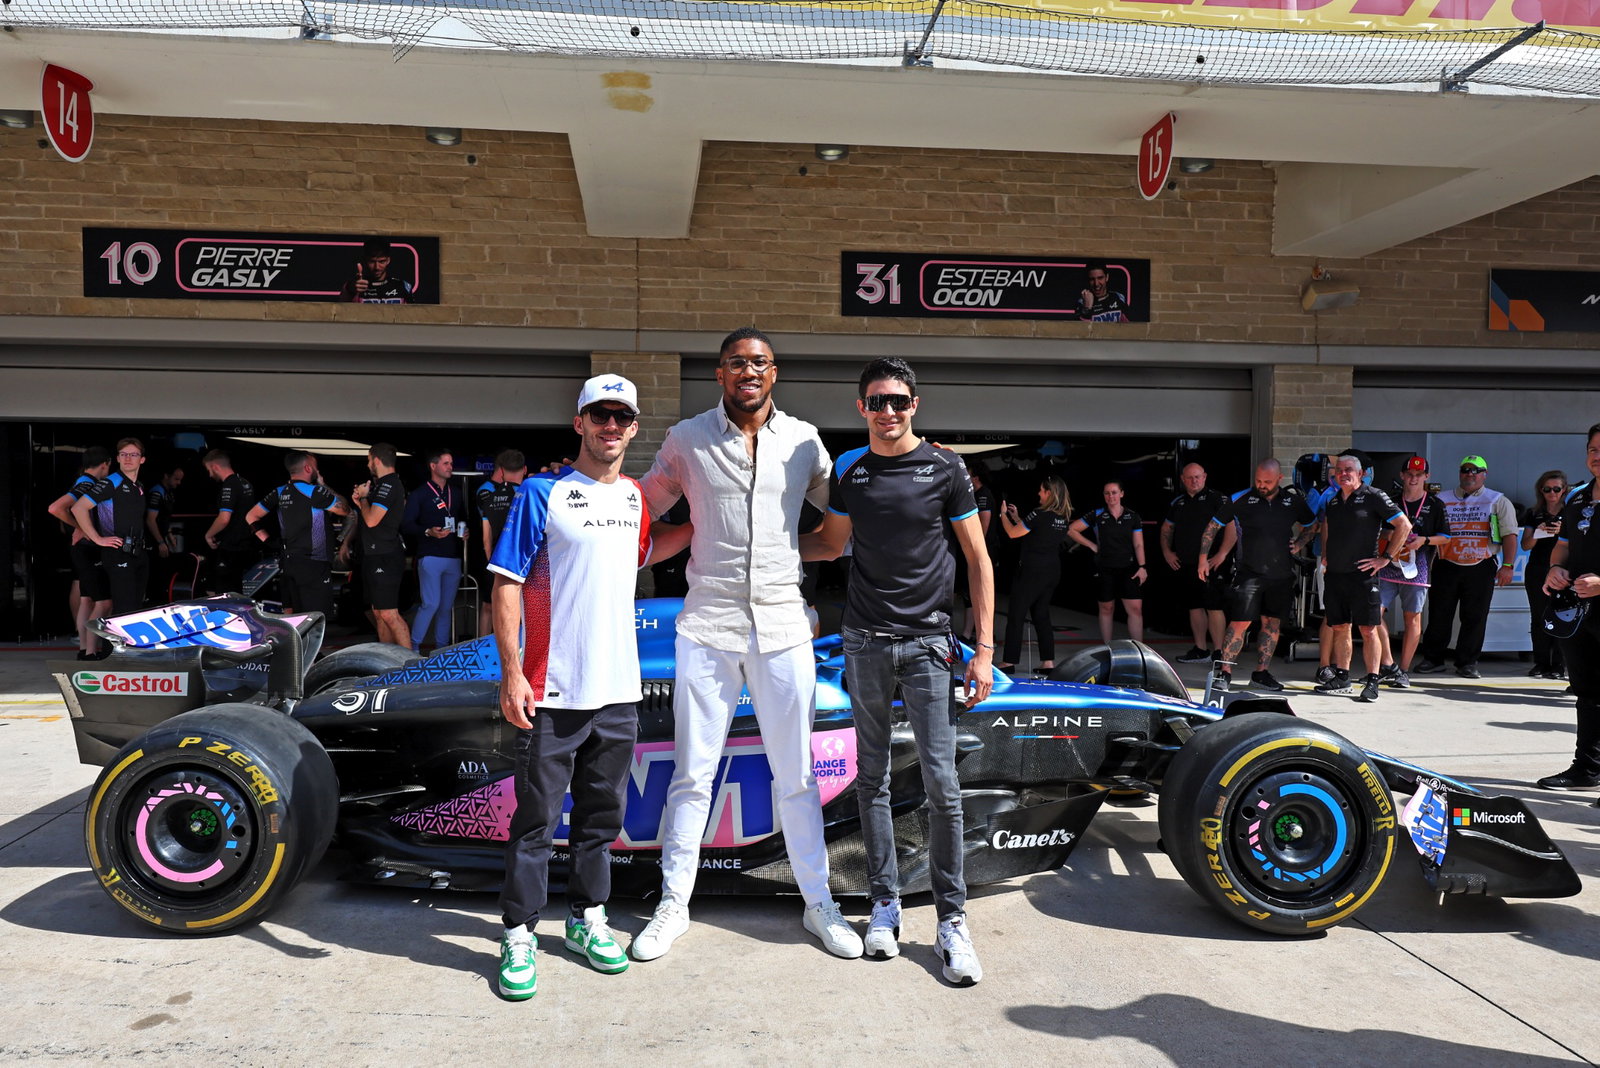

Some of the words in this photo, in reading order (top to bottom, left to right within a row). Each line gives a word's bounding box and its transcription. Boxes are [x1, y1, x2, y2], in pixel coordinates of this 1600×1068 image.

[57, 80, 79, 143] 14
[1148, 128, 1164, 182] 15
[100, 241, 162, 285] 10
[196, 246, 294, 267] PIERRE
[191, 267, 281, 288] GASLY
[855, 263, 901, 304] 31
[937, 268, 1047, 288] ESTEBAN
[932, 288, 1003, 306] OCON
[233, 426, 267, 435] GASLY
[291, 427, 303, 436] 10
[583, 519, 639, 529] ALPINE
[102, 674, 183, 693] Castrol
[991, 715, 1103, 728] ALPINE
[178, 736, 203, 748] P
[457, 760, 489, 774] ADA
[812, 758, 847, 770] ANGE
[1356, 761, 1392, 816] PIRELLI
[1473, 811, 1526, 824] Microsoft
[992, 828, 1075, 850] Canel's
[609, 853, 633, 864] hoo!
[697, 858, 742, 869] ANCE
